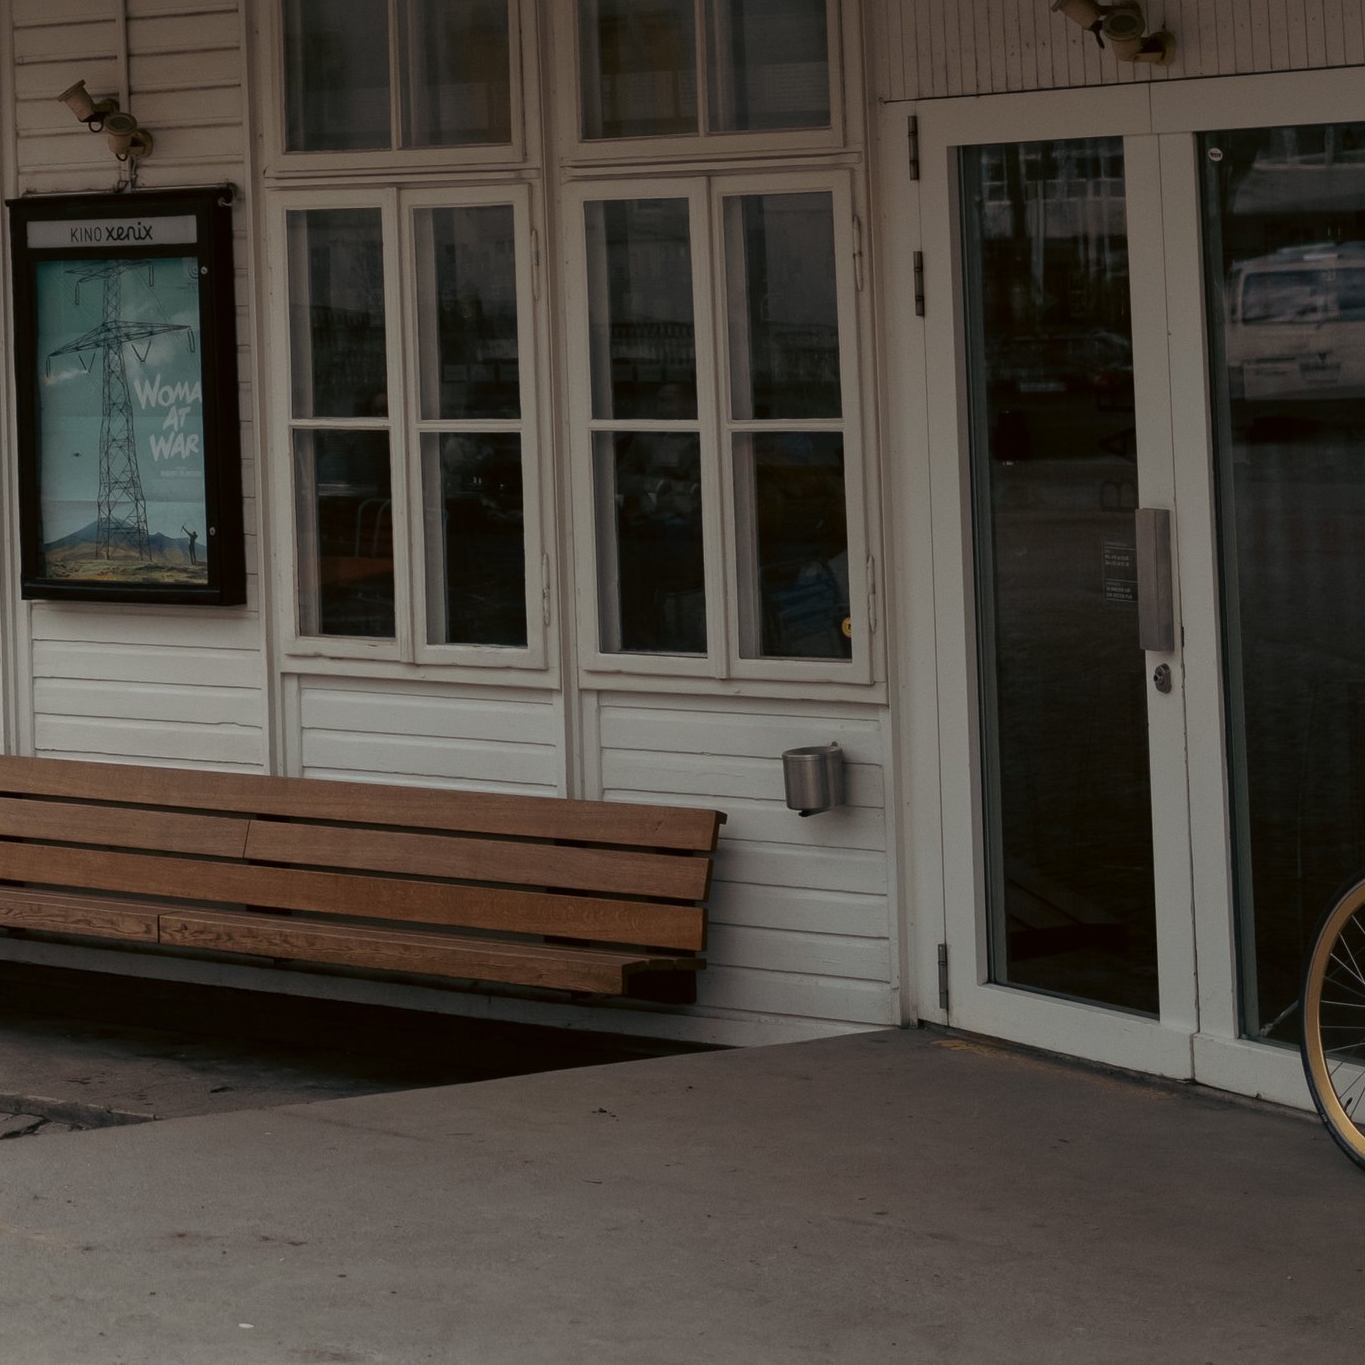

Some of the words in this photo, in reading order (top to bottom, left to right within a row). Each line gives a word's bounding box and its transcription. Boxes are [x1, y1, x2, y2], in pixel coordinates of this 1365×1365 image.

[70, 225, 103, 243] KINO
[105, 221, 154, 242] xenix
[162, 405, 192, 432] AT
[149, 431, 200, 463] WAR
